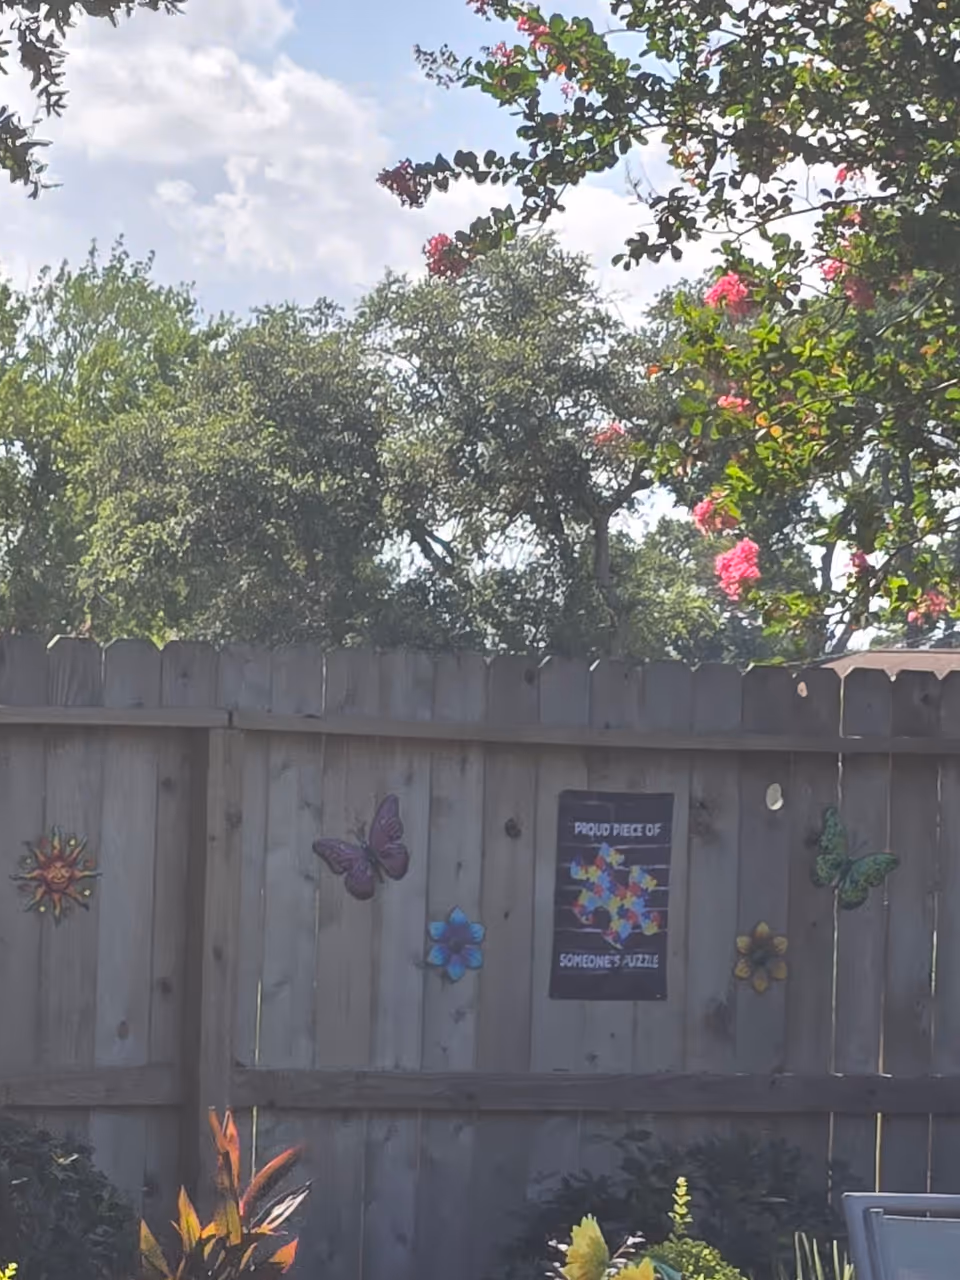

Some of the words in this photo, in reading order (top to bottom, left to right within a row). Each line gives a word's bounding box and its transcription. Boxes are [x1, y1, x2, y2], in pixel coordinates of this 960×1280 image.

[574, 821, 610, 837] PROUD
[613, 821, 643, 837] PIECE
[645, 821, 662, 837] OF
[559, 953, 621, 968] SOMEONE'S
[621, 953, 659, 968] PUZZLE
